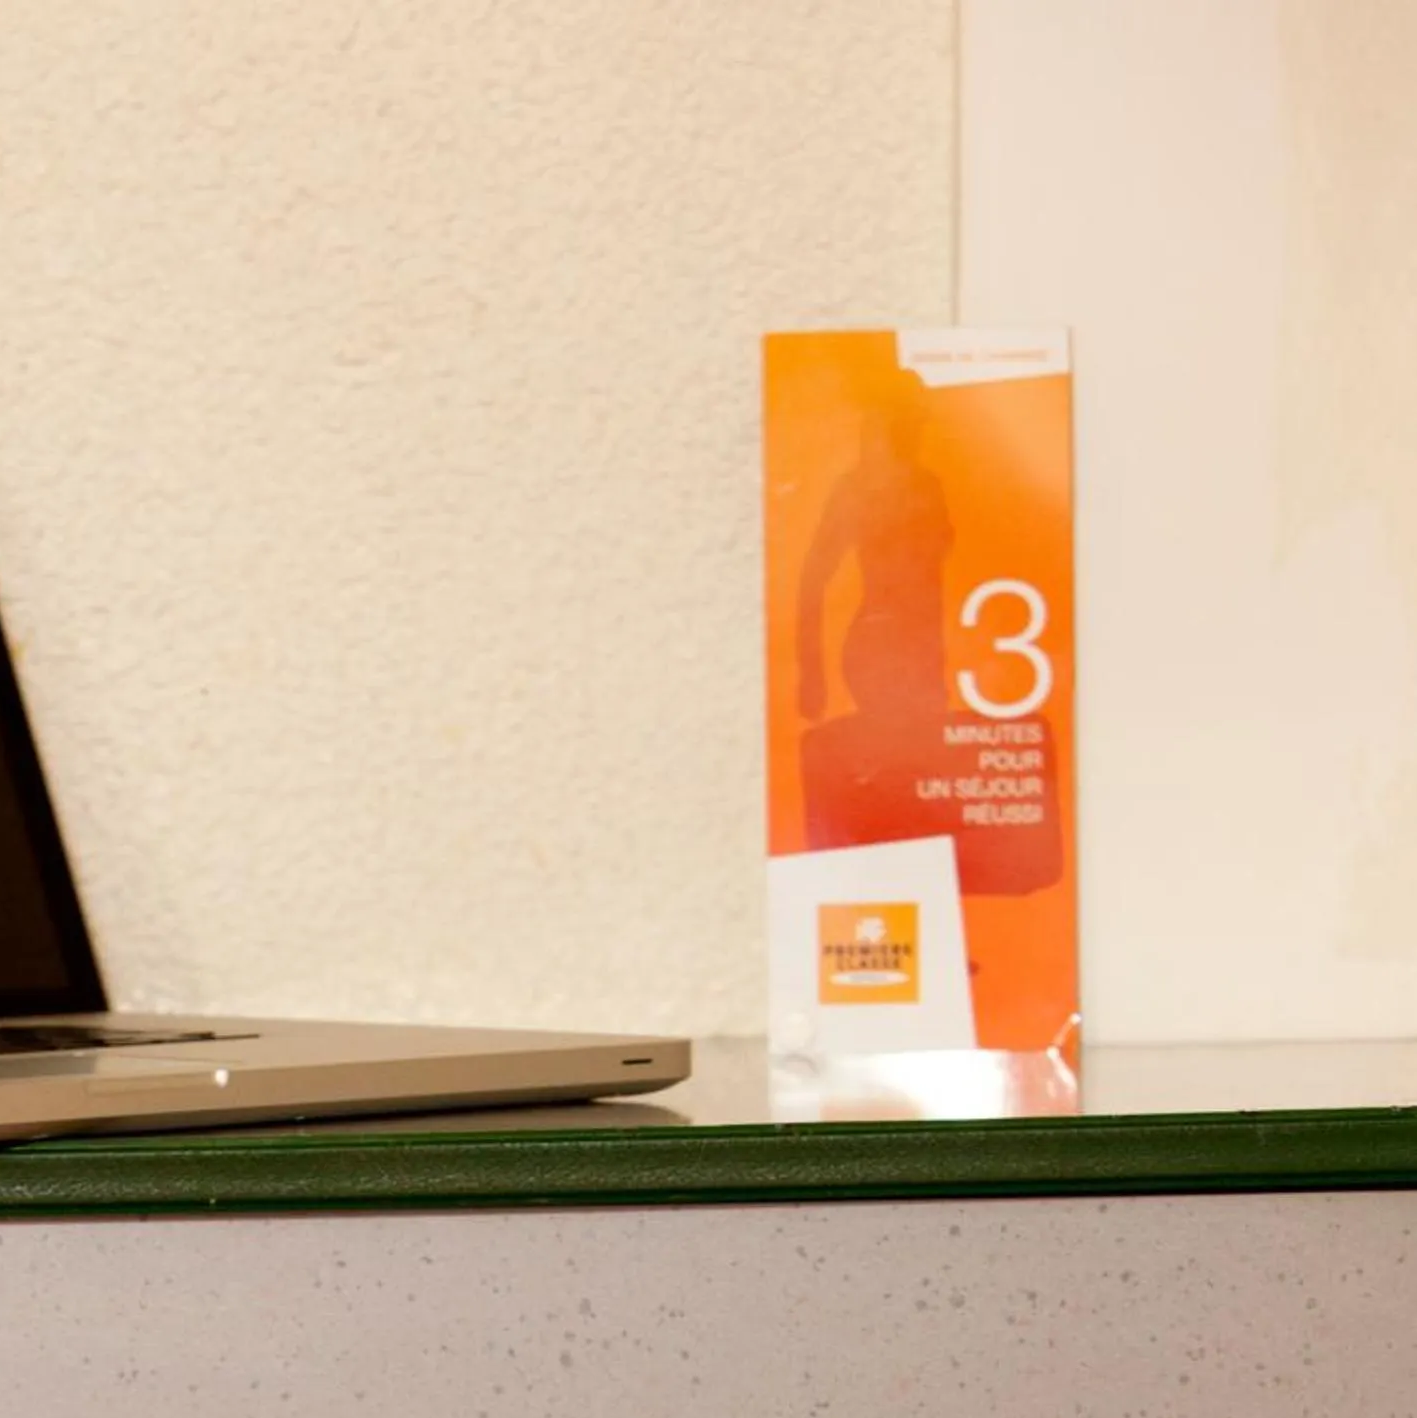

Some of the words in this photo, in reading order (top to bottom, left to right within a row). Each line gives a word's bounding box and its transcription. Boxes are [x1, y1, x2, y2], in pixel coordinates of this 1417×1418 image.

[956, 577, 1053, 719] 3
[943, 723, 1044, 744] MINUTES
[978, 749, 1044, 771] POUR
[916, 778, 951, 799] UN
